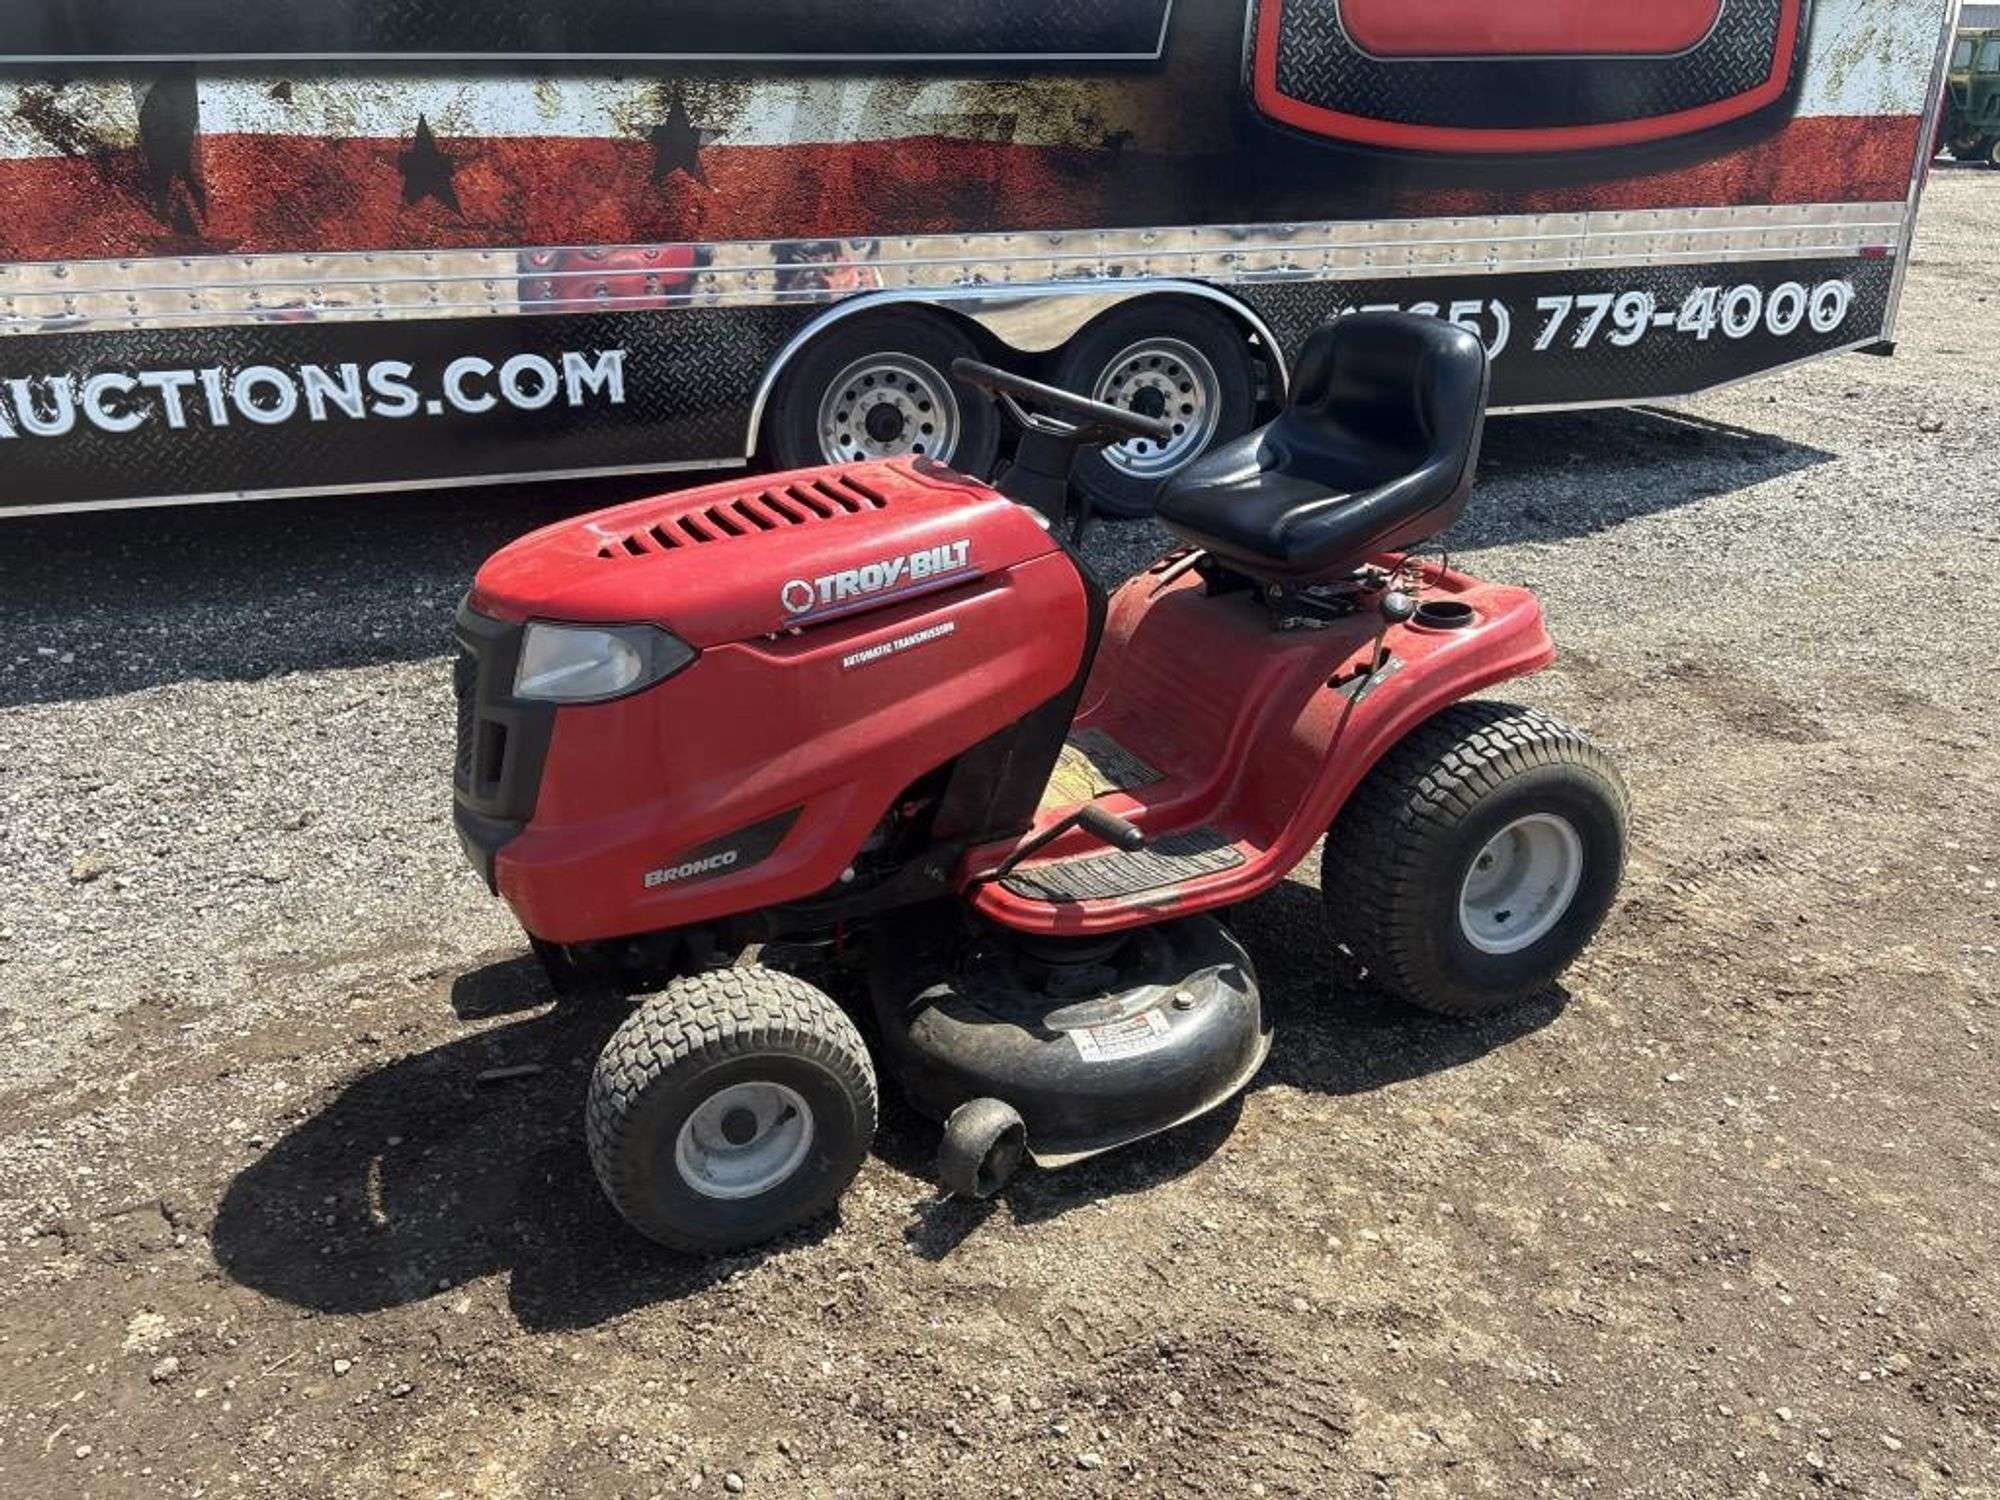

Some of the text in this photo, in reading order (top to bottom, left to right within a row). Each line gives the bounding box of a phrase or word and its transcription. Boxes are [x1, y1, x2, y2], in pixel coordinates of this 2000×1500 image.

[1532, 279, 1854, 351] 779-4000
[814, 539, 971, 603] TROY-BILT
[843, 621, 955, 668] AUTOMATIC TRANSMISSION
[643, 850, 738, 888] BRONCO
